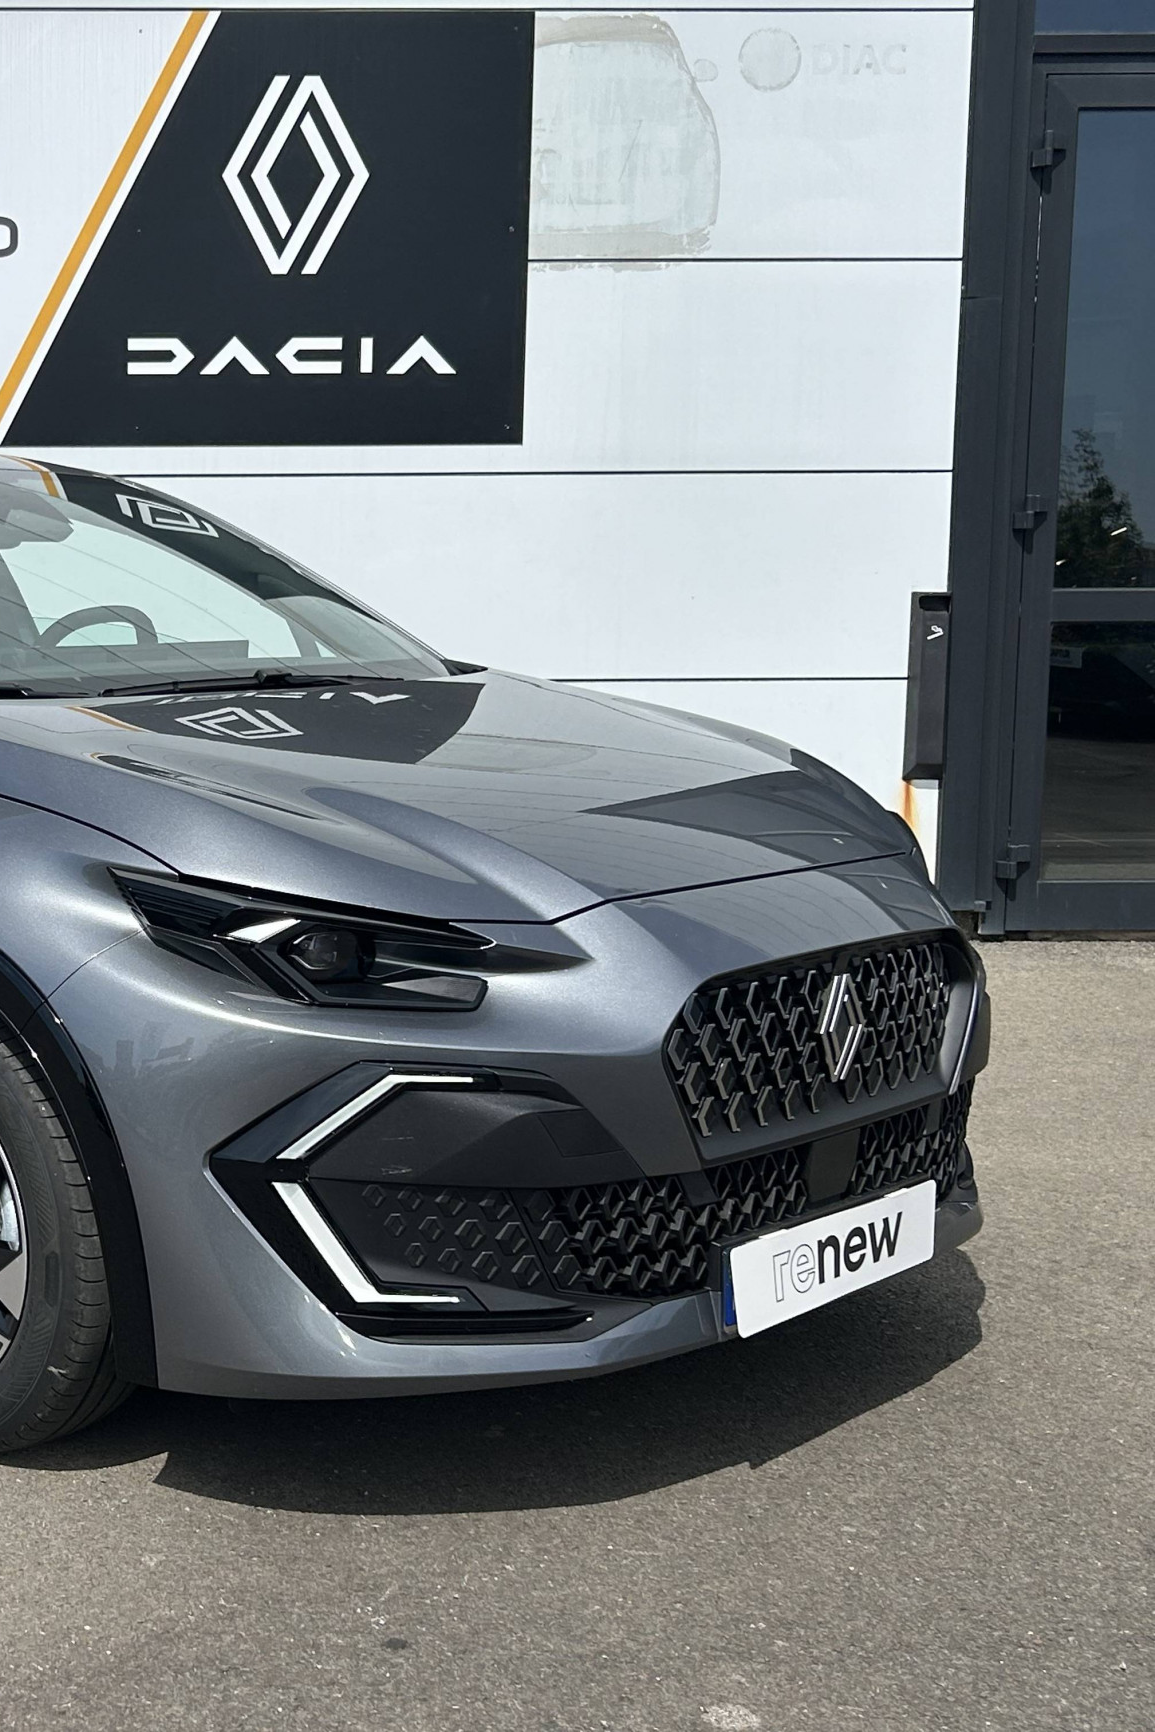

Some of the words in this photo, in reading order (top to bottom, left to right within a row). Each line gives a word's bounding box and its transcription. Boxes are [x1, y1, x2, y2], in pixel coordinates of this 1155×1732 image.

[812, 43, 907, 76] DIAC
[127, 335, 457, 375] DACIA
[772, 1211, 904, 1302] renew
